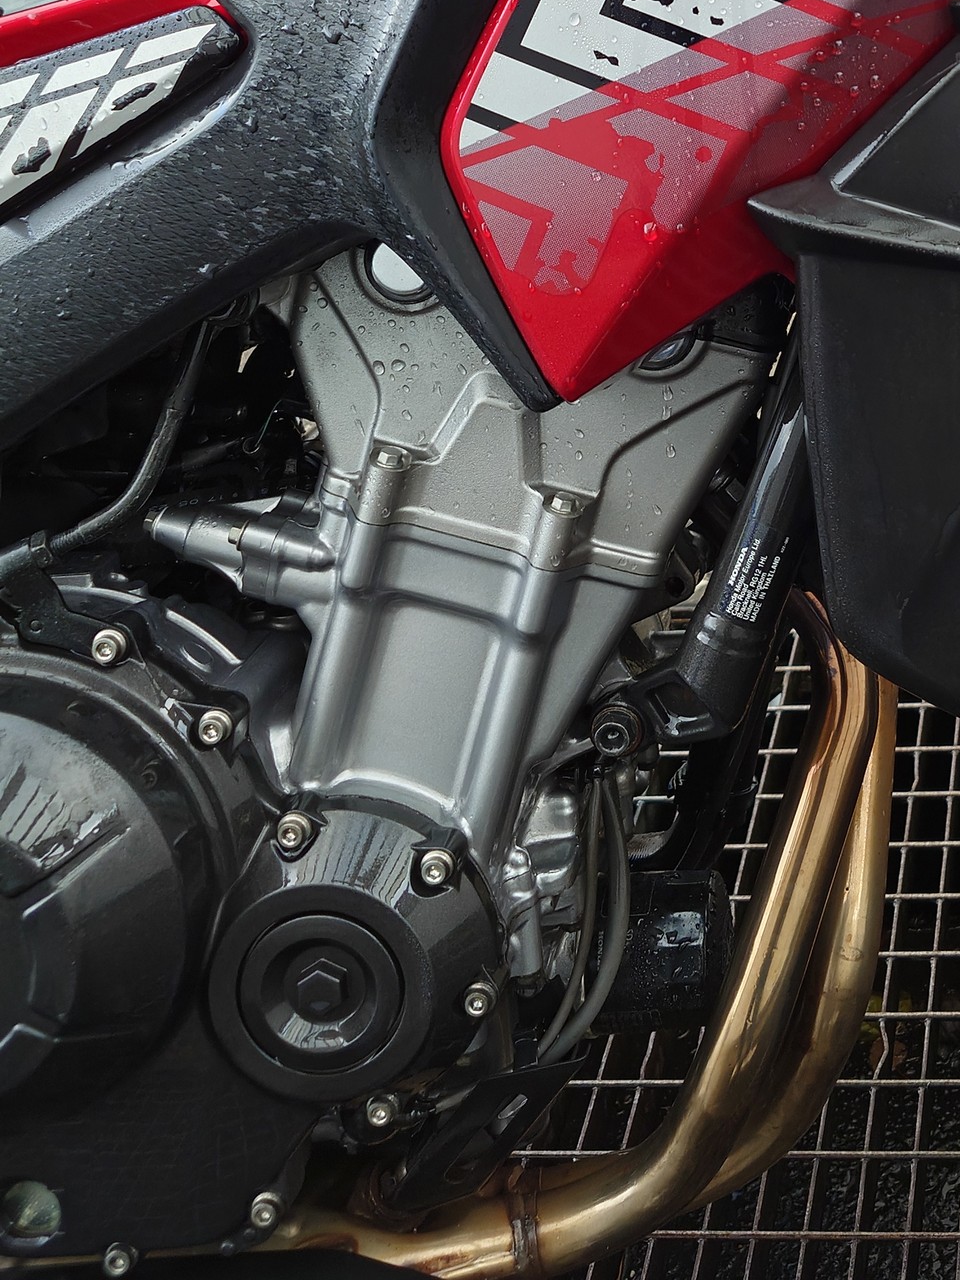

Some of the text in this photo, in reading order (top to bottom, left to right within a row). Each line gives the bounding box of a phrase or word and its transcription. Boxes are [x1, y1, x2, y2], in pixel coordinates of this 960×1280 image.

[726, 593, 738, 614] Honda
[734, 573, 746, 593] Motor
[742, 551, 756, 574] Europe
[728, 547, 748, 587] HONDA
[738, 583, 749, 601] Road
[750, 556, 781, 623] MADE IN THAILAND
[743, 600, 756, 621] United
